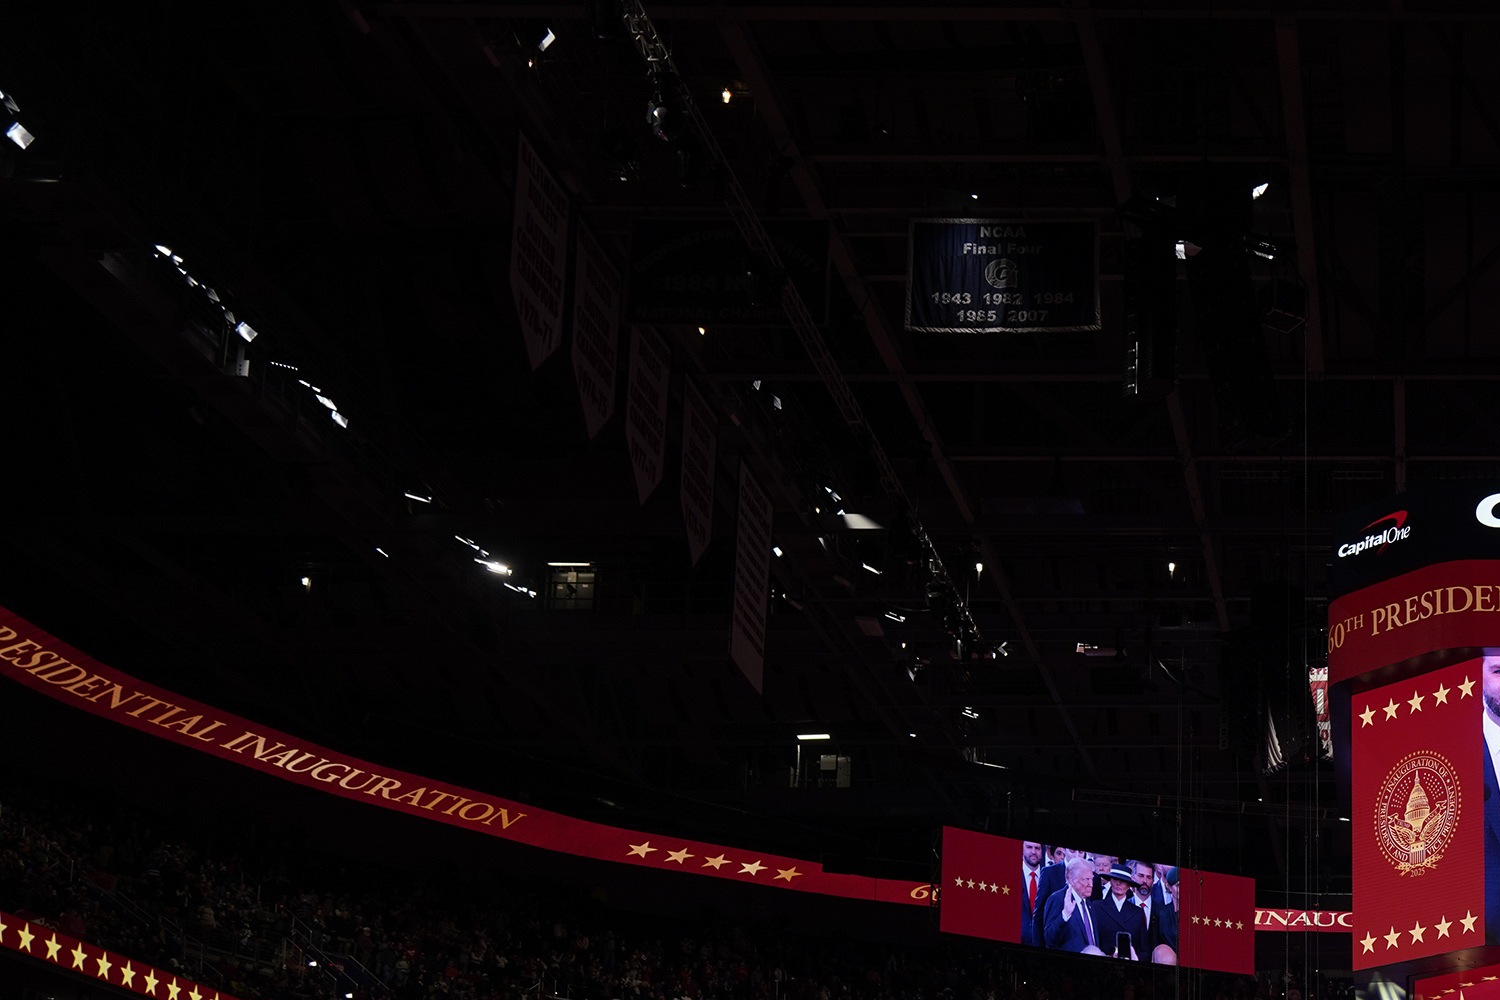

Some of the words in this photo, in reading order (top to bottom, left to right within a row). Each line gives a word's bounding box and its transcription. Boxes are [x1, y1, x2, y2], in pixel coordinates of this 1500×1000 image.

[527, 177, 558, 233] BULLETS
[526, 211, 555, 268] EASTERN
[963, 243, 1002, 255] Final
[1007, 243, 1043, 255] Four
[980, 226, 1026, 238] NCAA
[516, 226, 562, 293] CONFERENCE
[516, 253, 559, 319] CHAMPIONS
[932, 292, 972, 305] 1943
[983, 292, 1023, 305] 1982
[1034, 292, 1075, 304] 1984
[956, 309, 997, 322] 1985
[1007, 309, 1049, 322] 2007
[1328, 613, 1364, 654] 60TH
[220, 731, 527, 830] INAUGURATION
[1386, 758, 1439, 793] INAUGURATION
[1438, 766, 1449, 779] OF
[1380, 802, 1394, 852] PRESIDENT
[1392, 848, 1410, 862] AND
[1426, 839, 1444, 856] VICE
[1409, 866, 1427, 878] 2025
